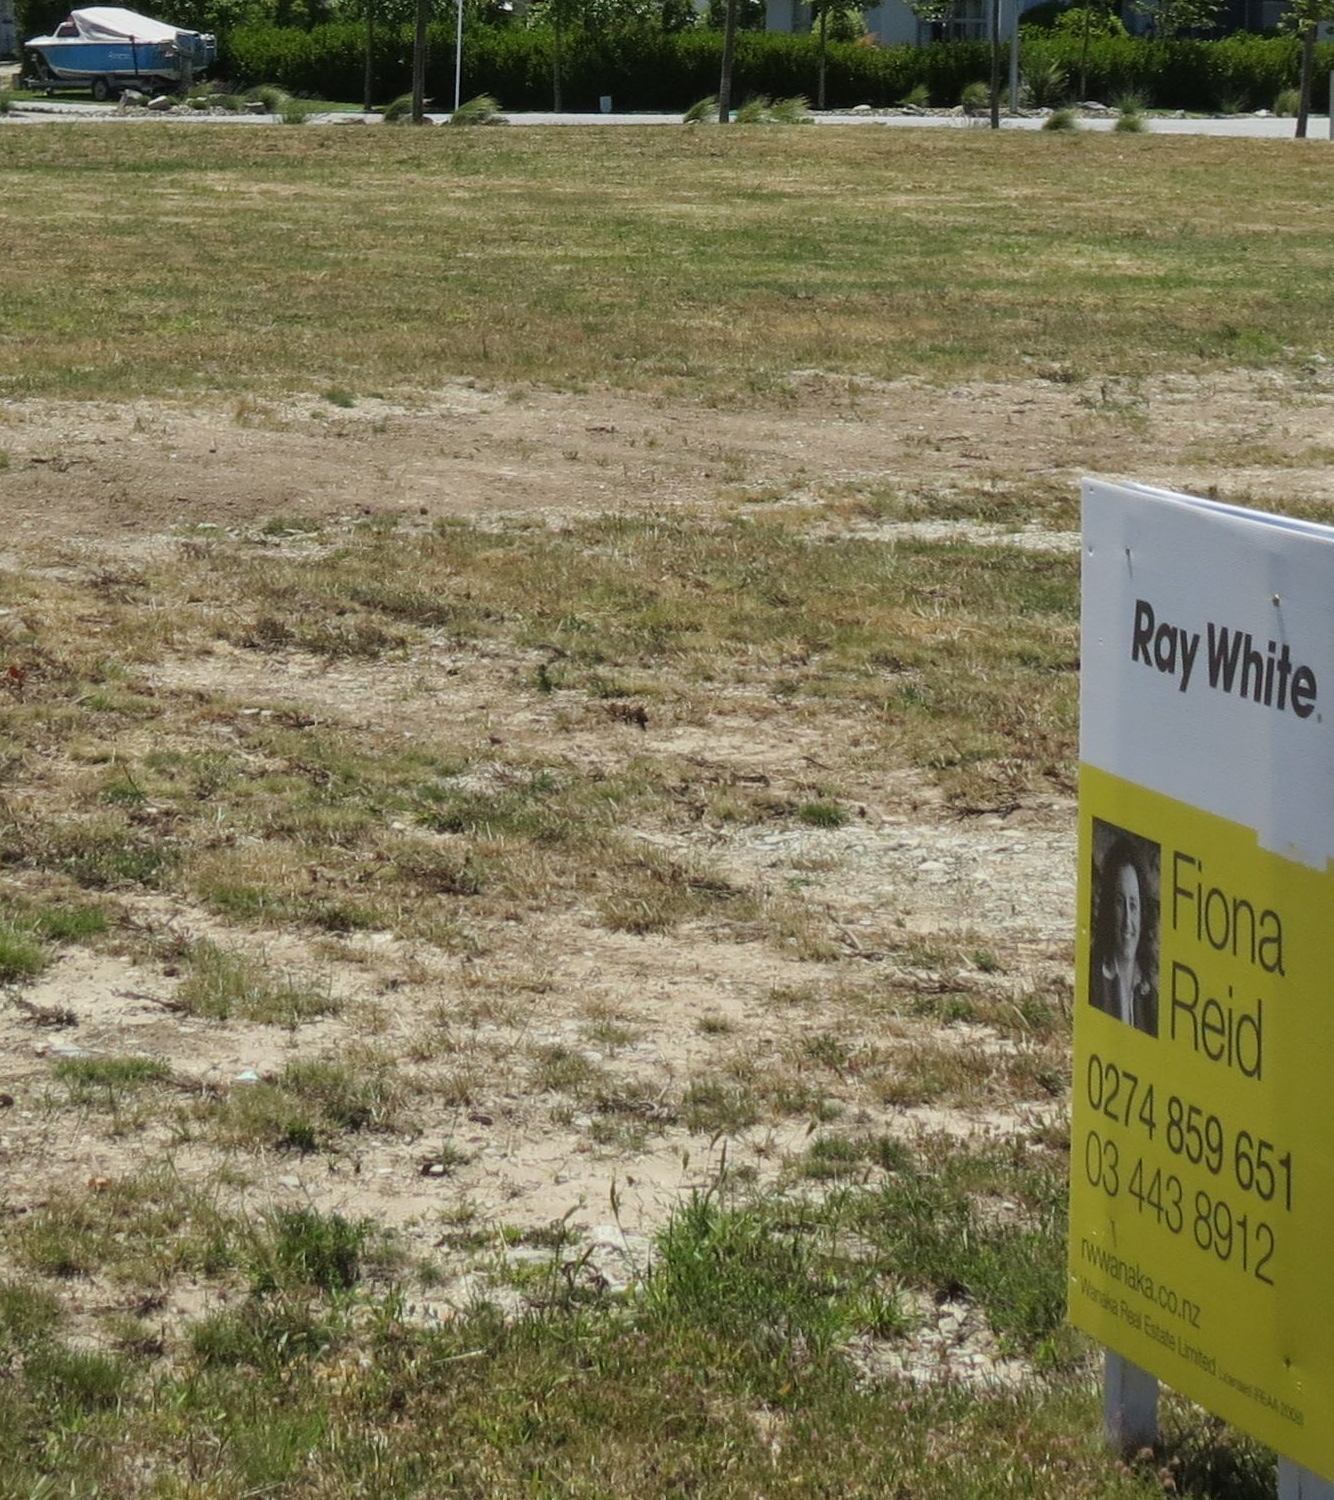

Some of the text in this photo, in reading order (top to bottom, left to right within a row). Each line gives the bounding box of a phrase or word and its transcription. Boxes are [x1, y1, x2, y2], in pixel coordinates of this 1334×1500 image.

[1131, 598, 1201, 694] Ray
[1172, 849, 1285, 978] Fiona
[1170, 959, 1263, 1082] Reid
[1087, 1053, 1292, 1212] 0274 859 651
[1085, 1130, 1275, 1287] 03 443 8912
[1081, 1236, 1202, 1331] rwwanaka.co.nz
[1120, 1300, 1142, 1331] Real
[1144, 1313, 1176, 1352] Estate
[1177, 1335, 1217, 1377] Limited
